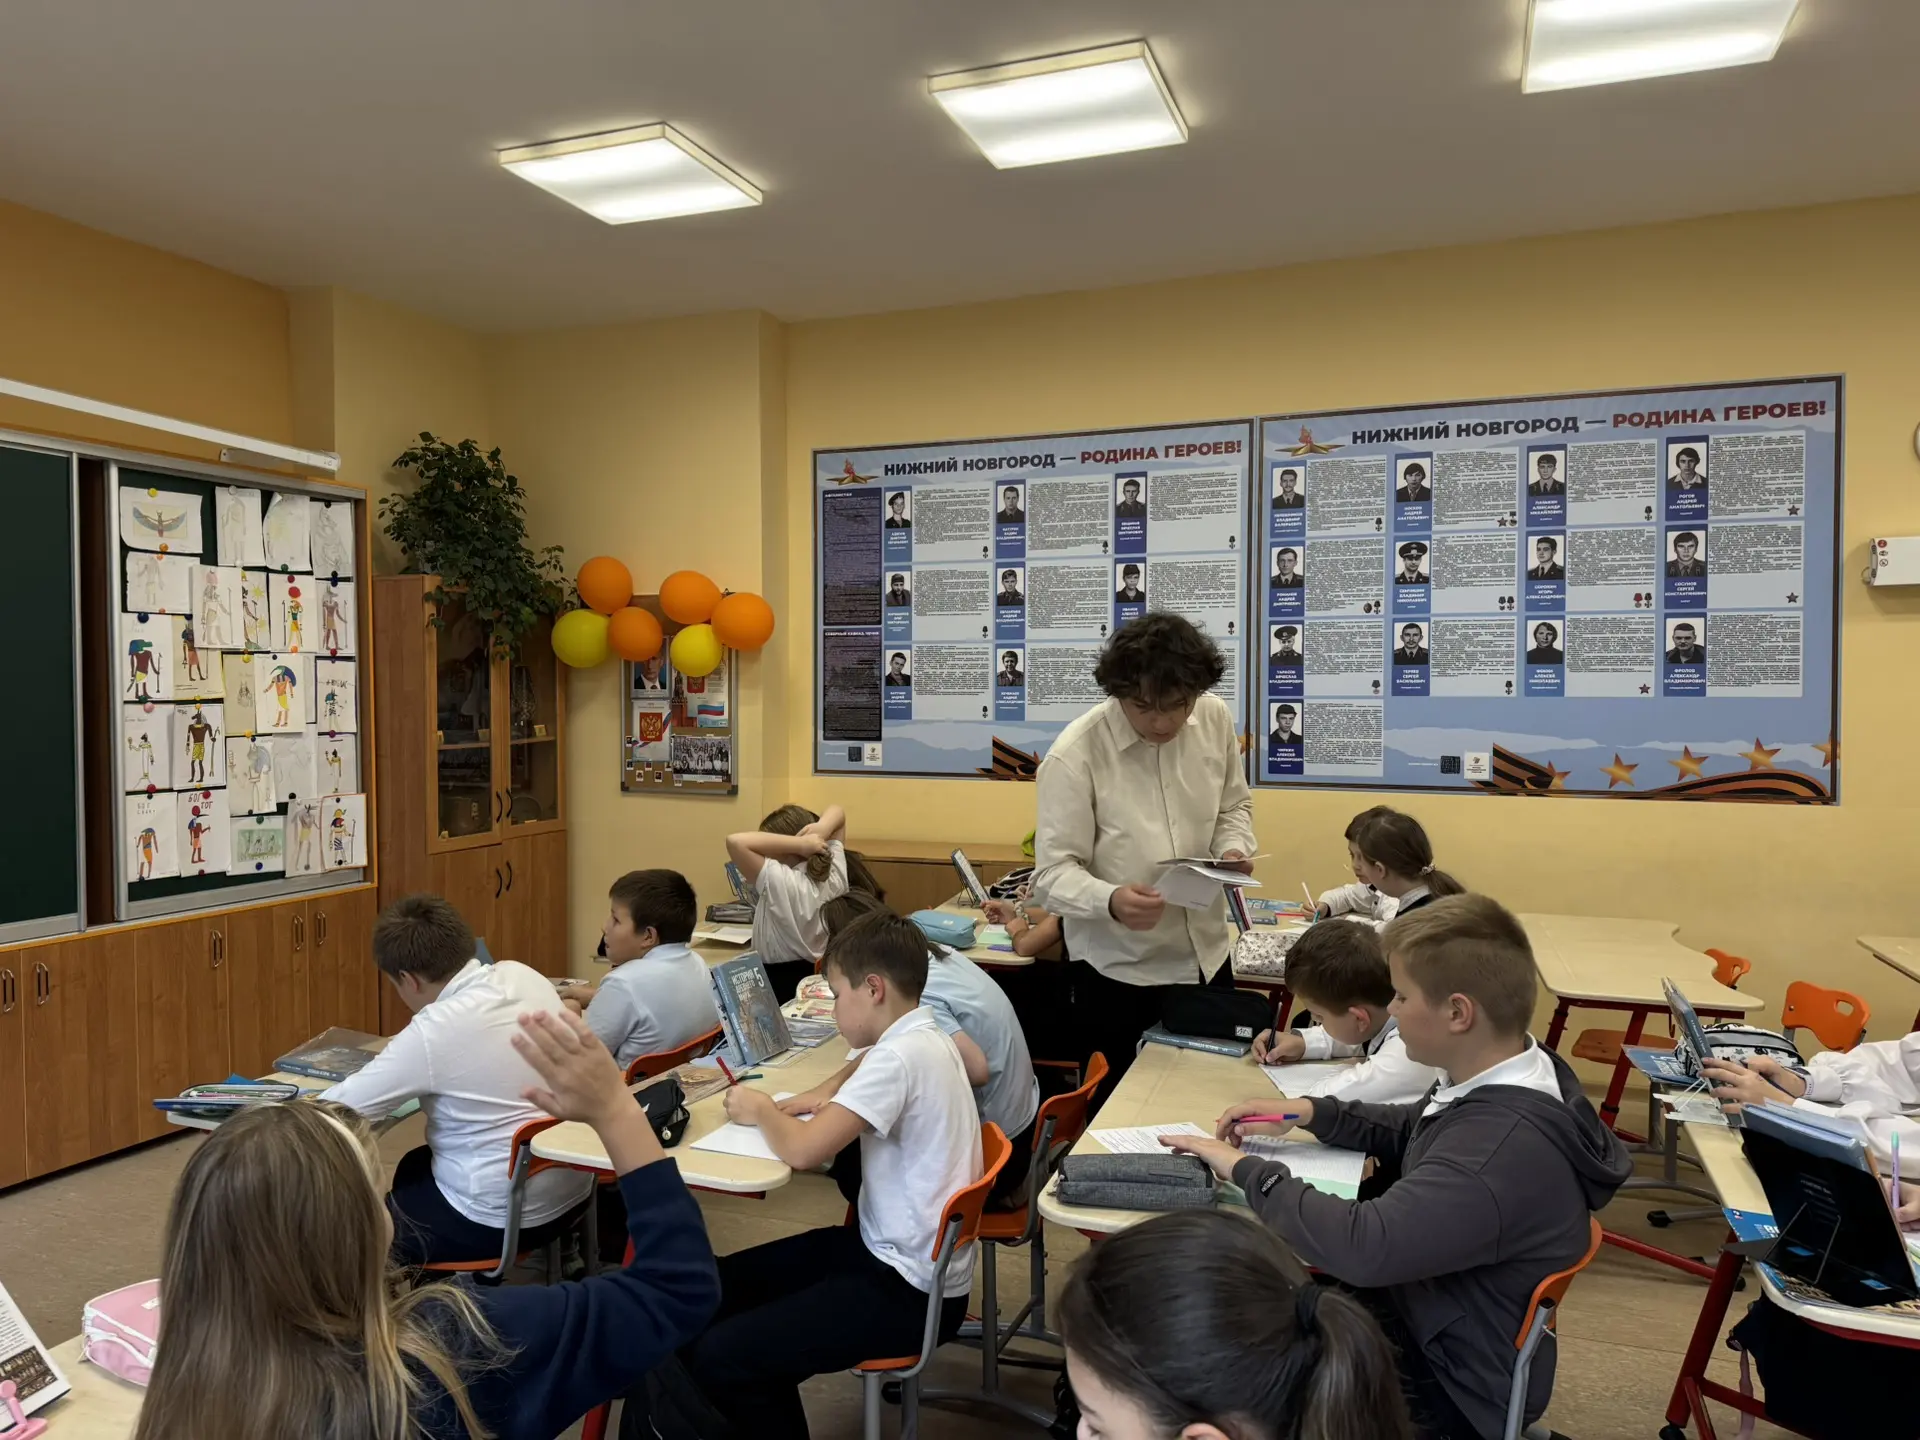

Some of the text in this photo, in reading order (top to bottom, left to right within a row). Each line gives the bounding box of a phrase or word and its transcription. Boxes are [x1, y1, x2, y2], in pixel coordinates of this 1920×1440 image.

[1352, 421, 1449, 445] НИЖНИЙ
[1456, 416, 1579, 438] НОВГОРОД
[1613, 407, 1716, 428] РОДИНА
[1723, 400, 1826, 421] ГЕРОЕВ!
[884, 457, 958, 476] НИЖНИЙ
[963, 453, 1056, 472] НОВГОРОД
[1081, 446, 1159, 464] РОДИНА
[1164, 440, 1242, 458] ГЕРОЕВ!
[753, 967, 764, 988] 5
